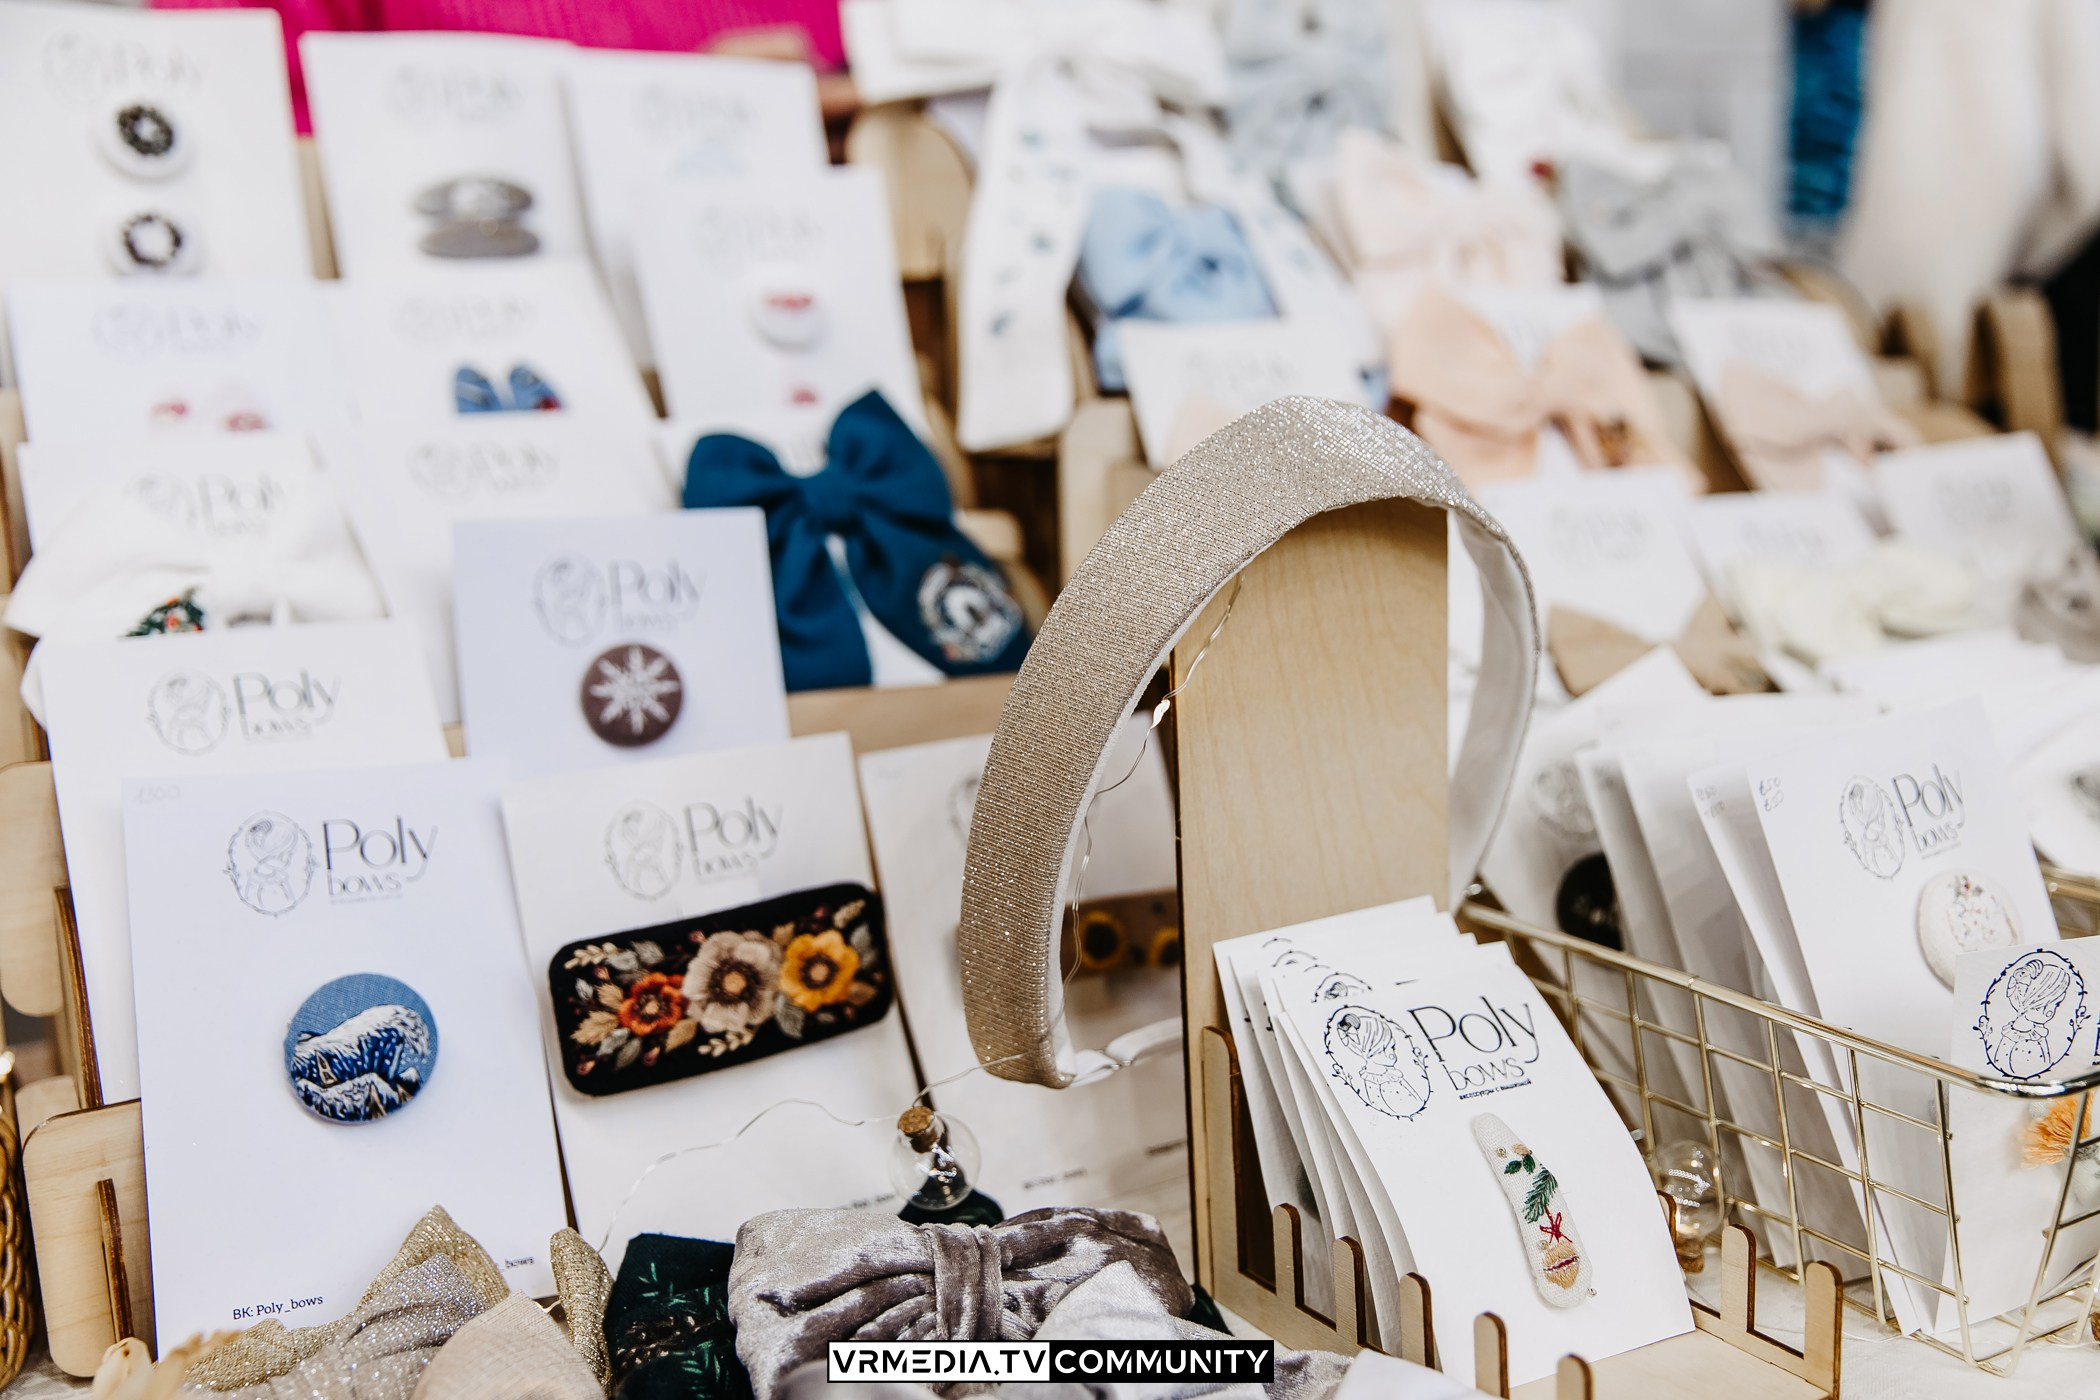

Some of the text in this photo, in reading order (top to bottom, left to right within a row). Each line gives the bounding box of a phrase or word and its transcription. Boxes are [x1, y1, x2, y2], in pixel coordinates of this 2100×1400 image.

[608, 557, 708, 624] Poly
[233, 668, 341, 725] Poly
[1891, 763, 1965, 829] Poly
[323, 814, 438, 882] Poly
[683, 795, 783, 860] Poly
[1909, 822, 1958, 853] bows
[327, 868, 402, 897] bows
[1406, 995, 1539, 1063] Poly
[1442, 1057, 1525, 1091] bows
[256, 1295, 324, 1316] Poly_bows
